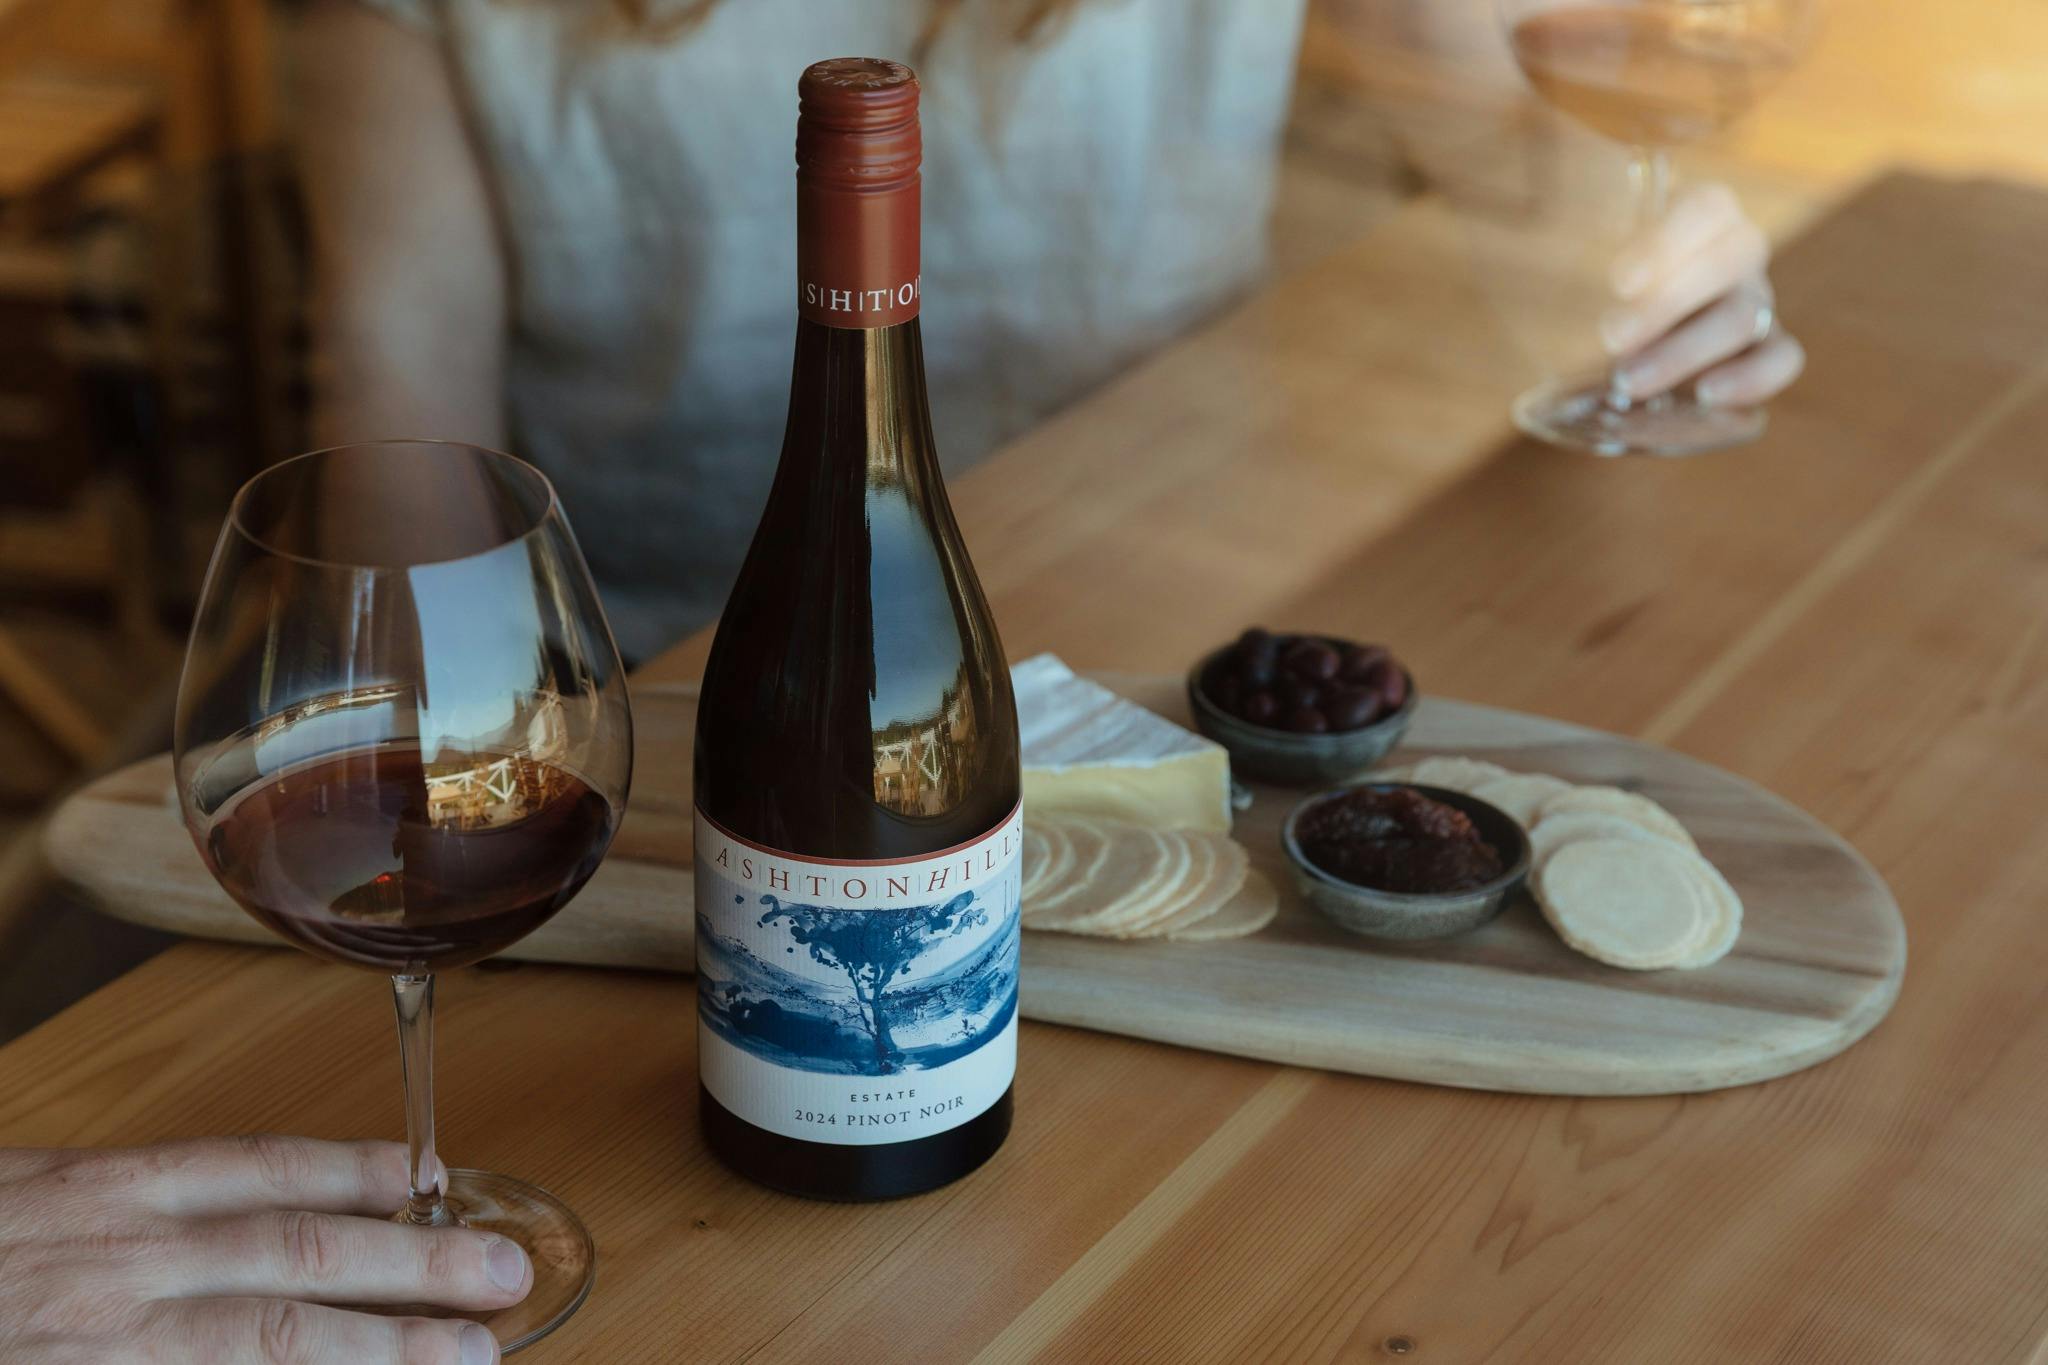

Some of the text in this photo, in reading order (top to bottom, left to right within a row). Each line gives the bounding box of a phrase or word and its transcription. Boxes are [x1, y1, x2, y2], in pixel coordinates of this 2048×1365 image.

[806, 275, 921, 312] SHTO
[794, 1095, 965, 1127] 2024 PINOT NOIR
[850, 1089, 916, 1102] ESTATE
